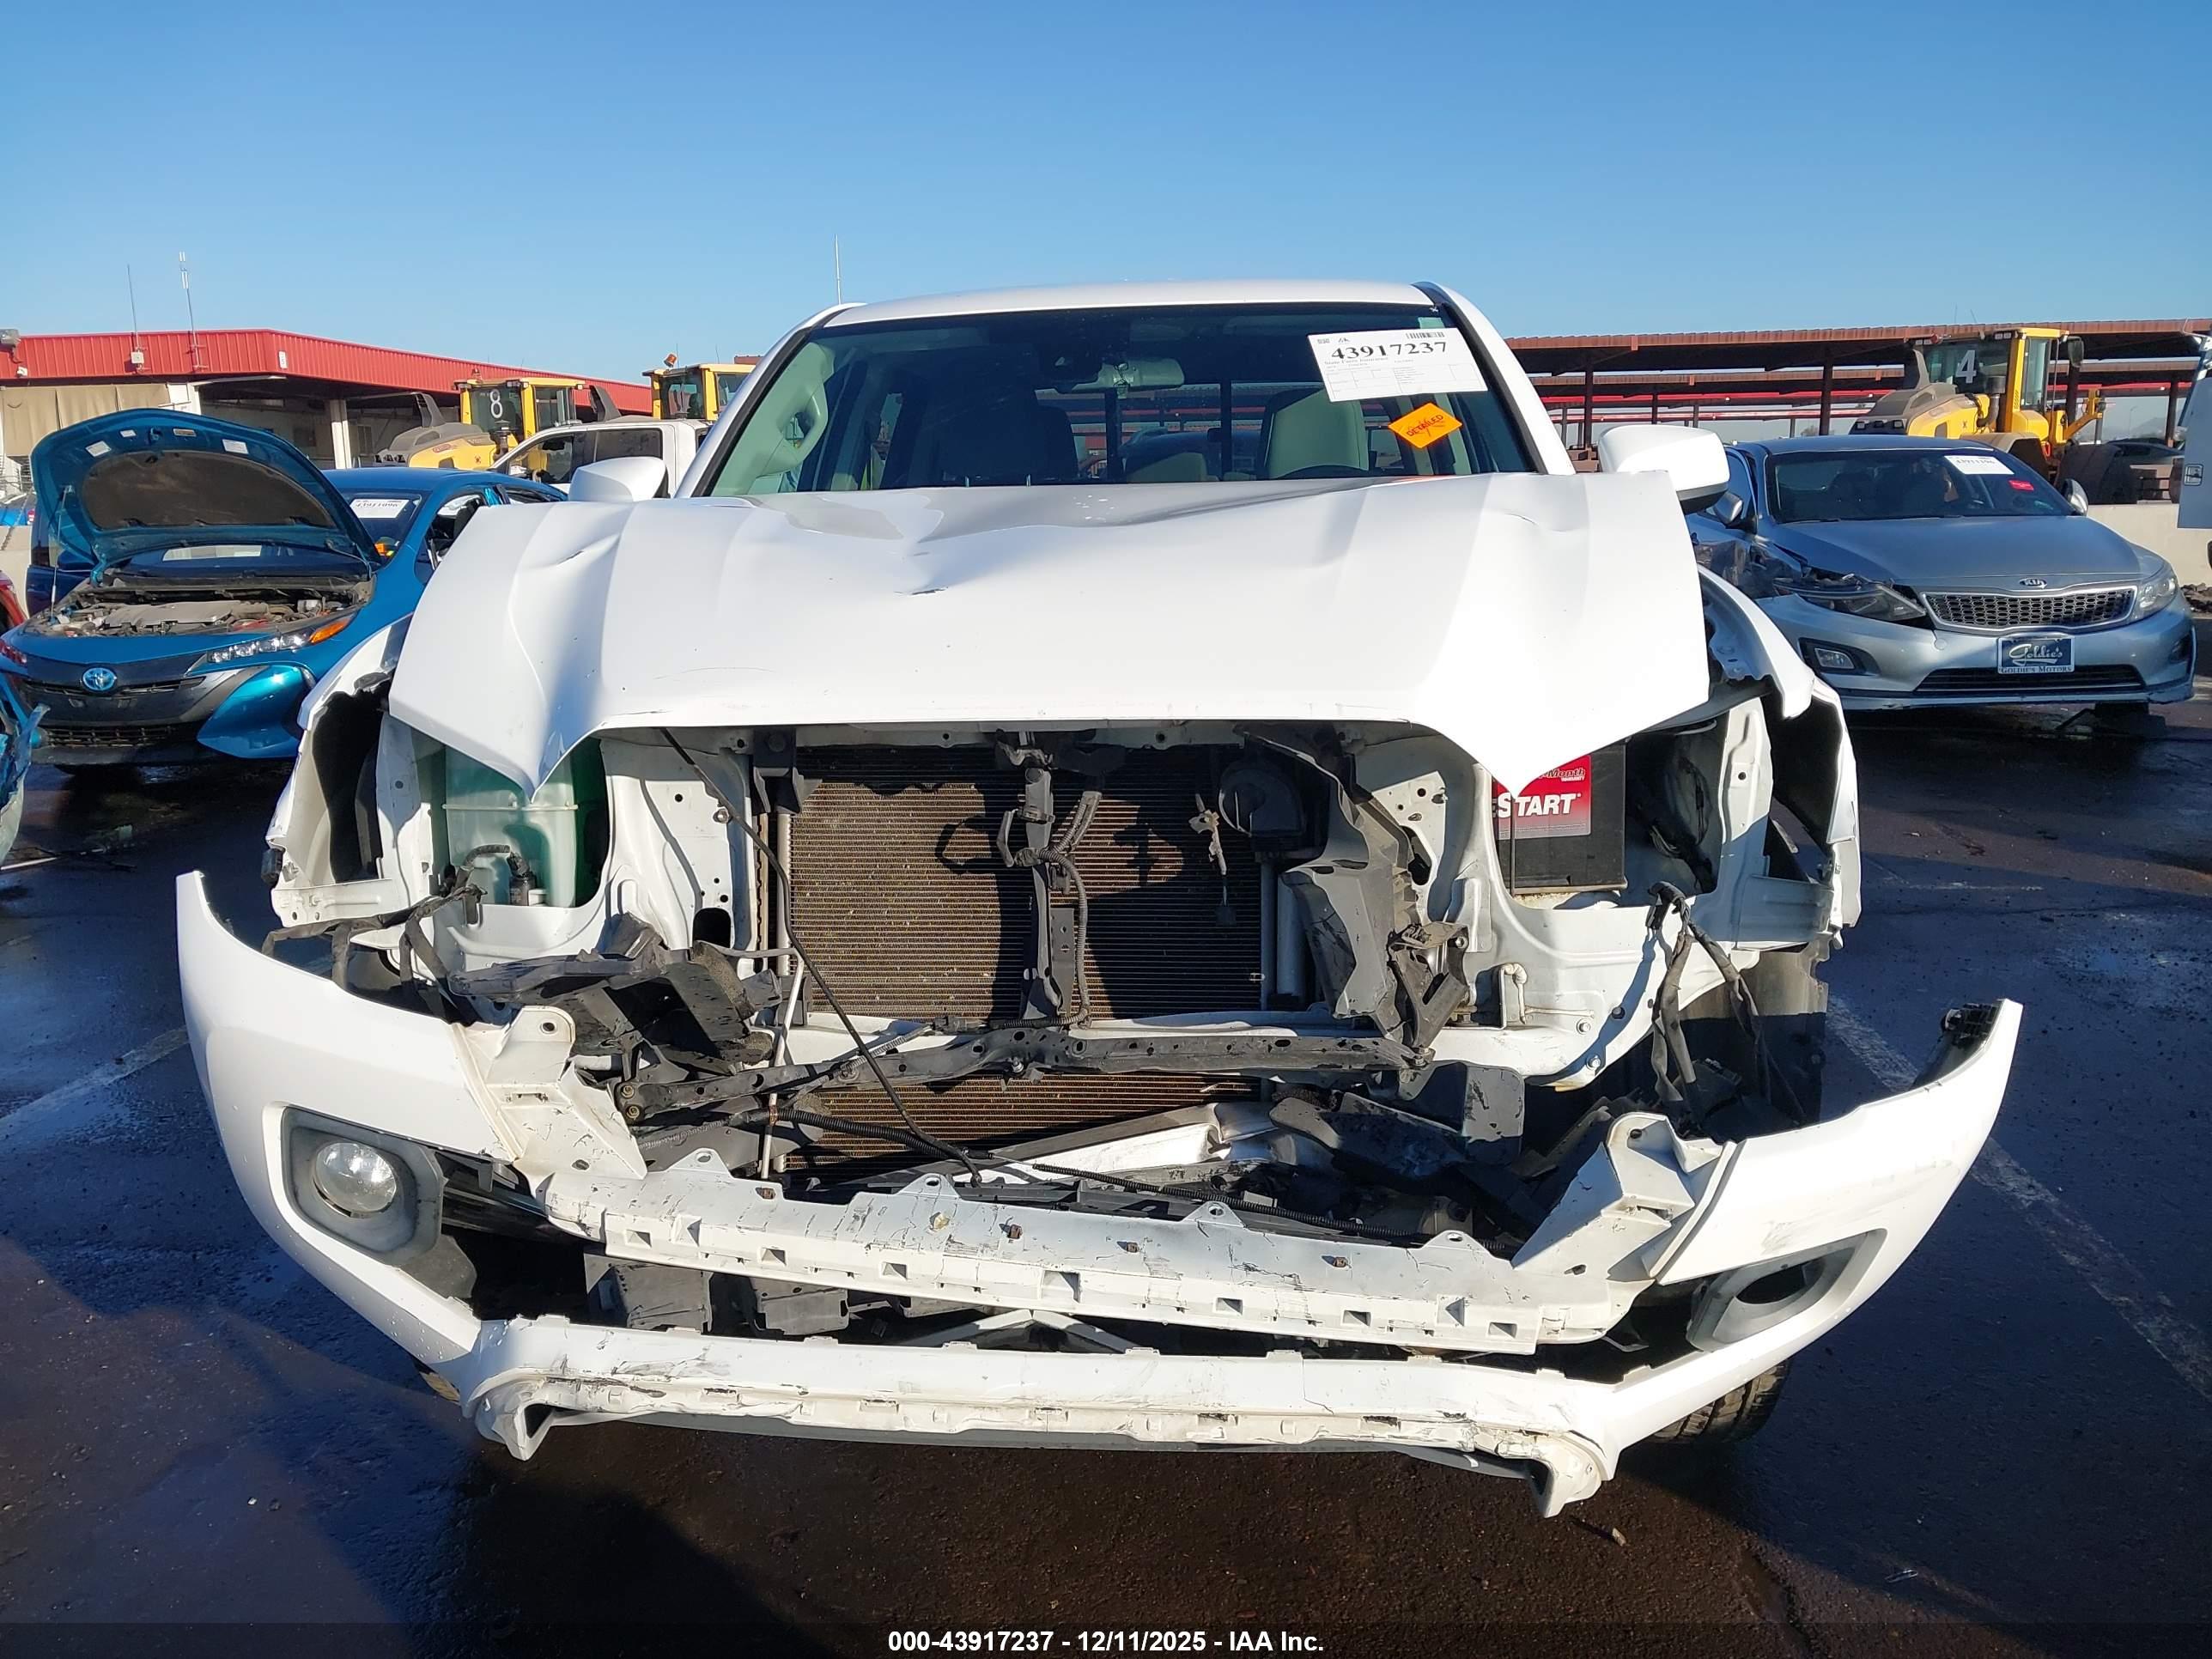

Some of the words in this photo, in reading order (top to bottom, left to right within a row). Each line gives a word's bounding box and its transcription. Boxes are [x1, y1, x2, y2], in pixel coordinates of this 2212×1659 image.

[1331, 342, 1447, 360] 43917237
[1955, 349, 1977, 384] 4
[489, 389, 503, 419] 8
[1407, 414, 1444, 437] DETAILED
[2008, 643, 2063, 667] Goldie's
